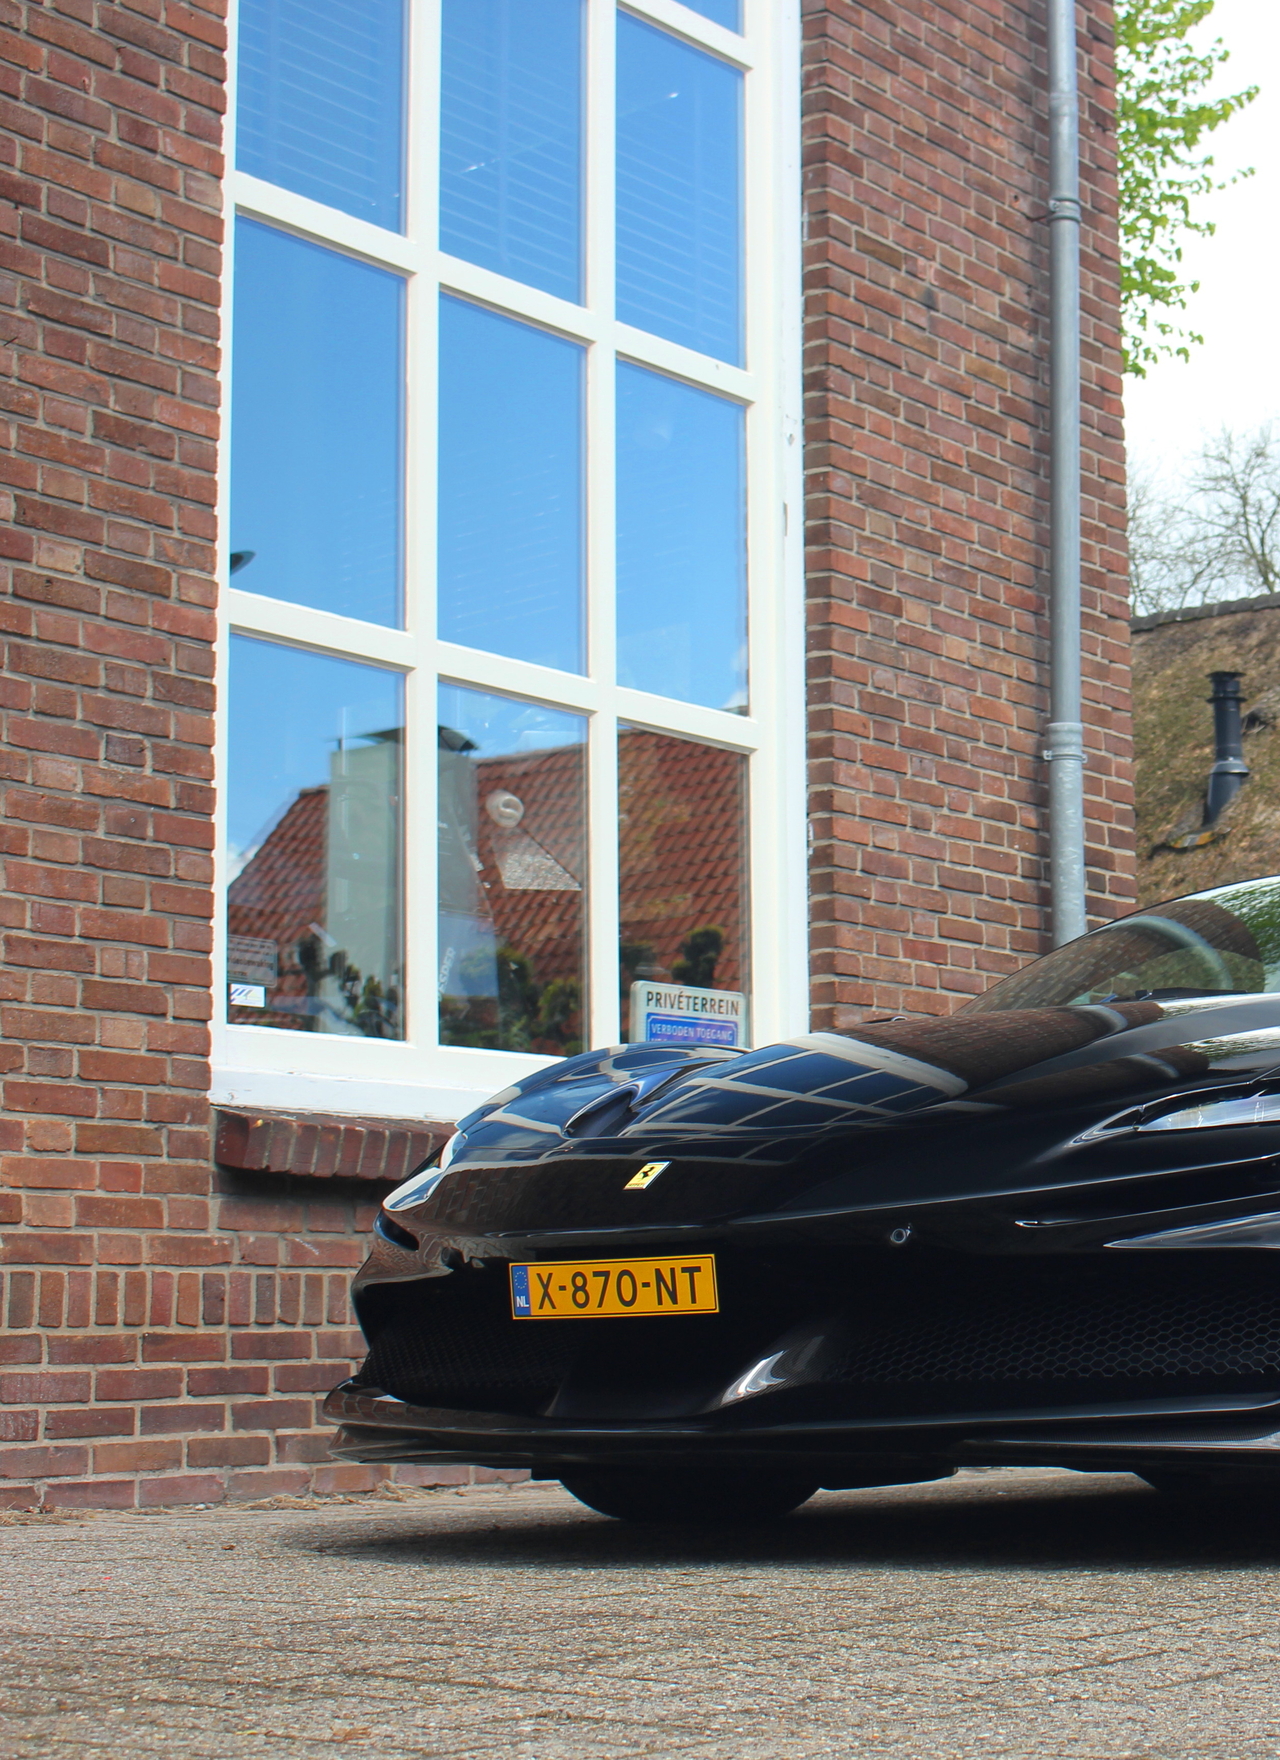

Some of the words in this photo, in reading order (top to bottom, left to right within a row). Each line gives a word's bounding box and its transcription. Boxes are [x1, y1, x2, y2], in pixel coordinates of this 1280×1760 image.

[646, 991, 739, 1015] PRIVÉTERREIN
[651, 1024, 695, 1037] VERBODEN
[696, 1027, 734, 1041] TOEGANG
[536, 1265, 702, 1310] X-870-NT
[516, 1295, 530, 1308] NL
